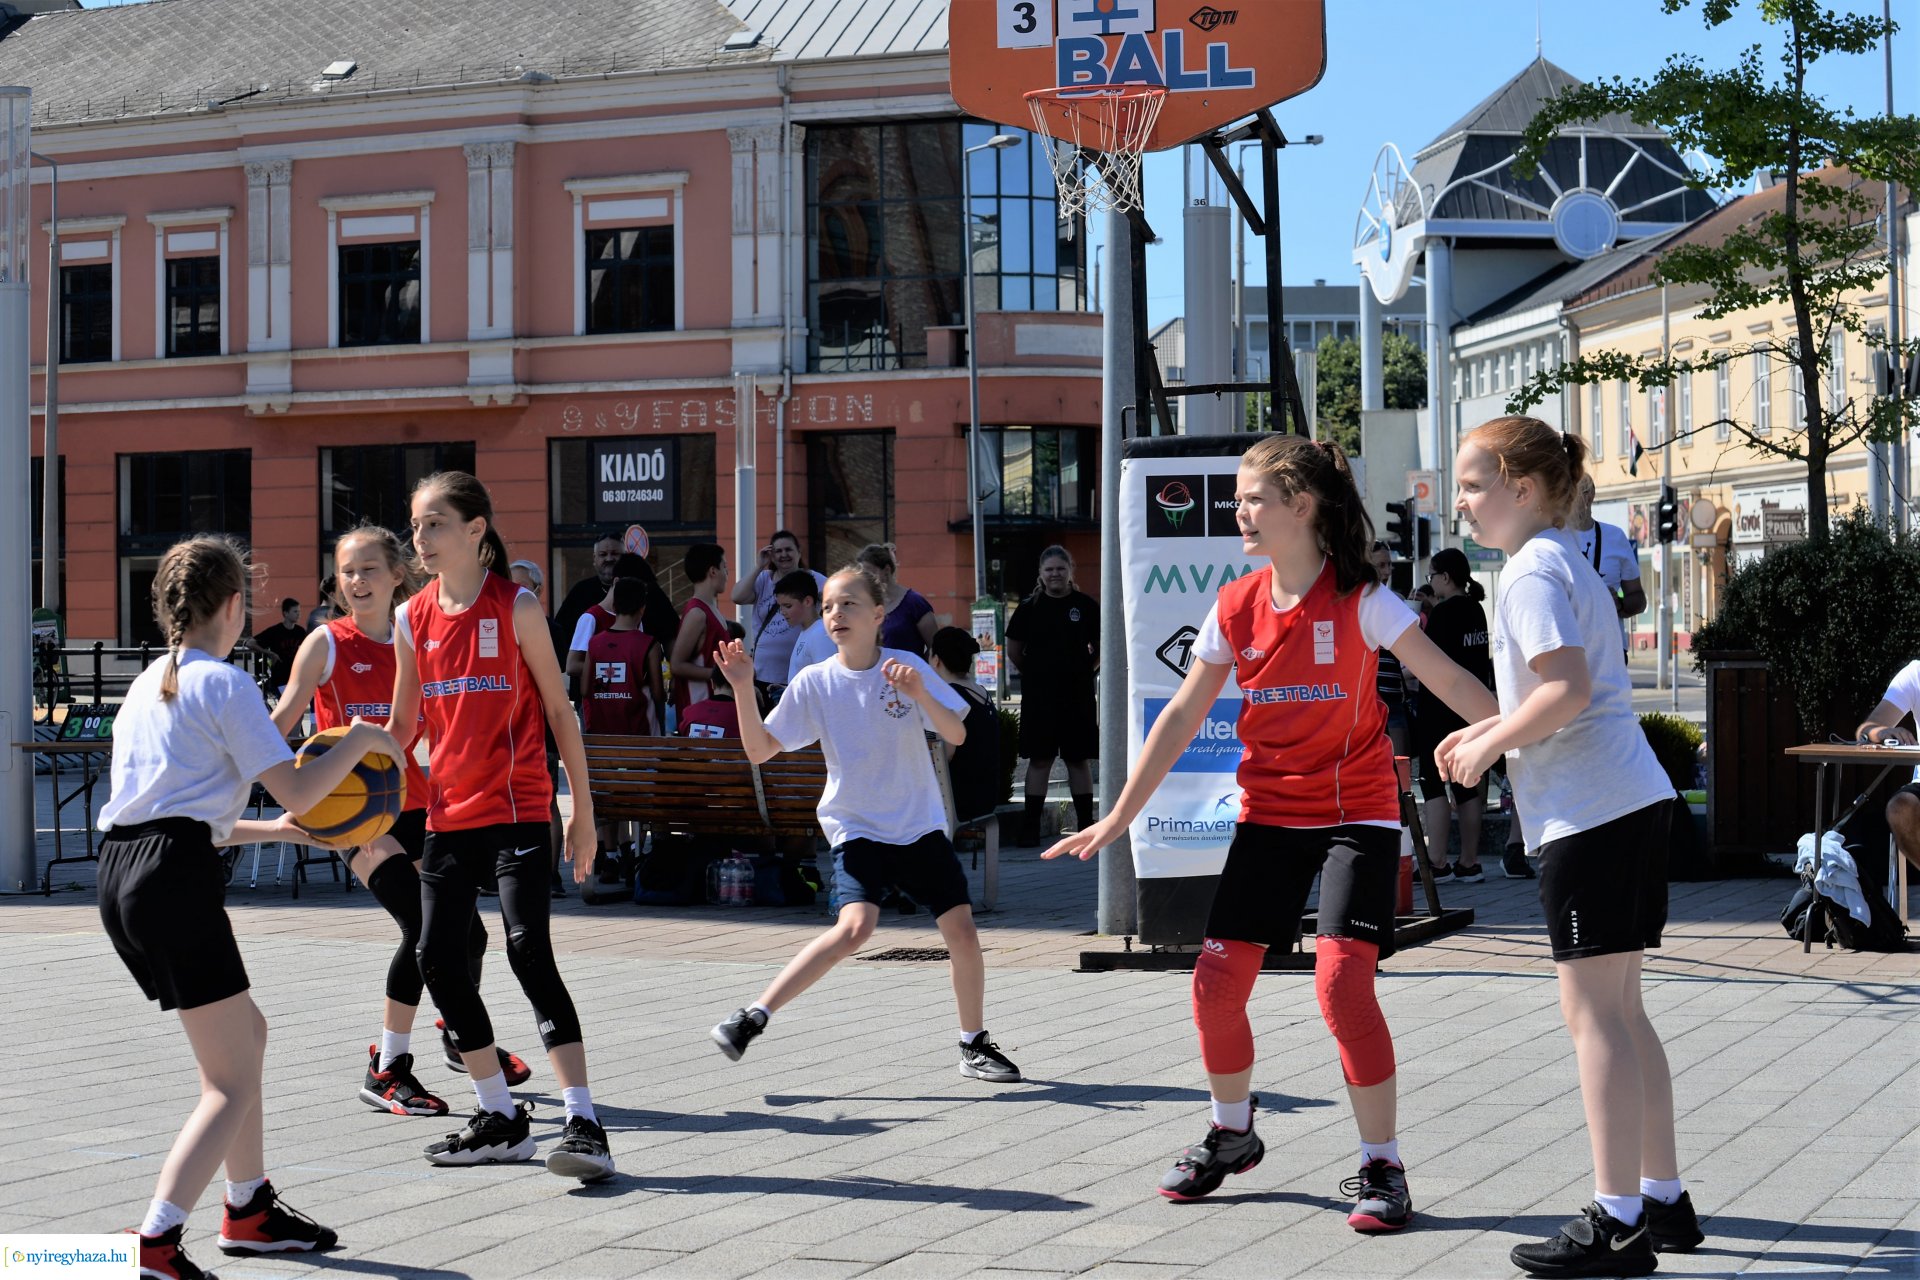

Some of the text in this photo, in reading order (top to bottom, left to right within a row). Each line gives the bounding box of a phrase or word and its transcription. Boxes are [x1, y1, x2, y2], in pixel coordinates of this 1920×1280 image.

[1012, 1, 1037, 34] 3
[1200, 8, 1238, 26] TOTI
[1056, 29, 1255, 97] BALL
[1193, 198, 1206, 206] 36
[652, 393, 872, 429] FASHION
[600, 448, 665, 483] KIADÓ
[422, 675, 512, 699] STREETBALL
[1243, 683, 1348, 705] TREETBALL
[65, 716, 114, 737] 3 00 6
[1148, 816, 1237, 833] Primaver
[1570, 910, 1579, 945] KIPSTA
